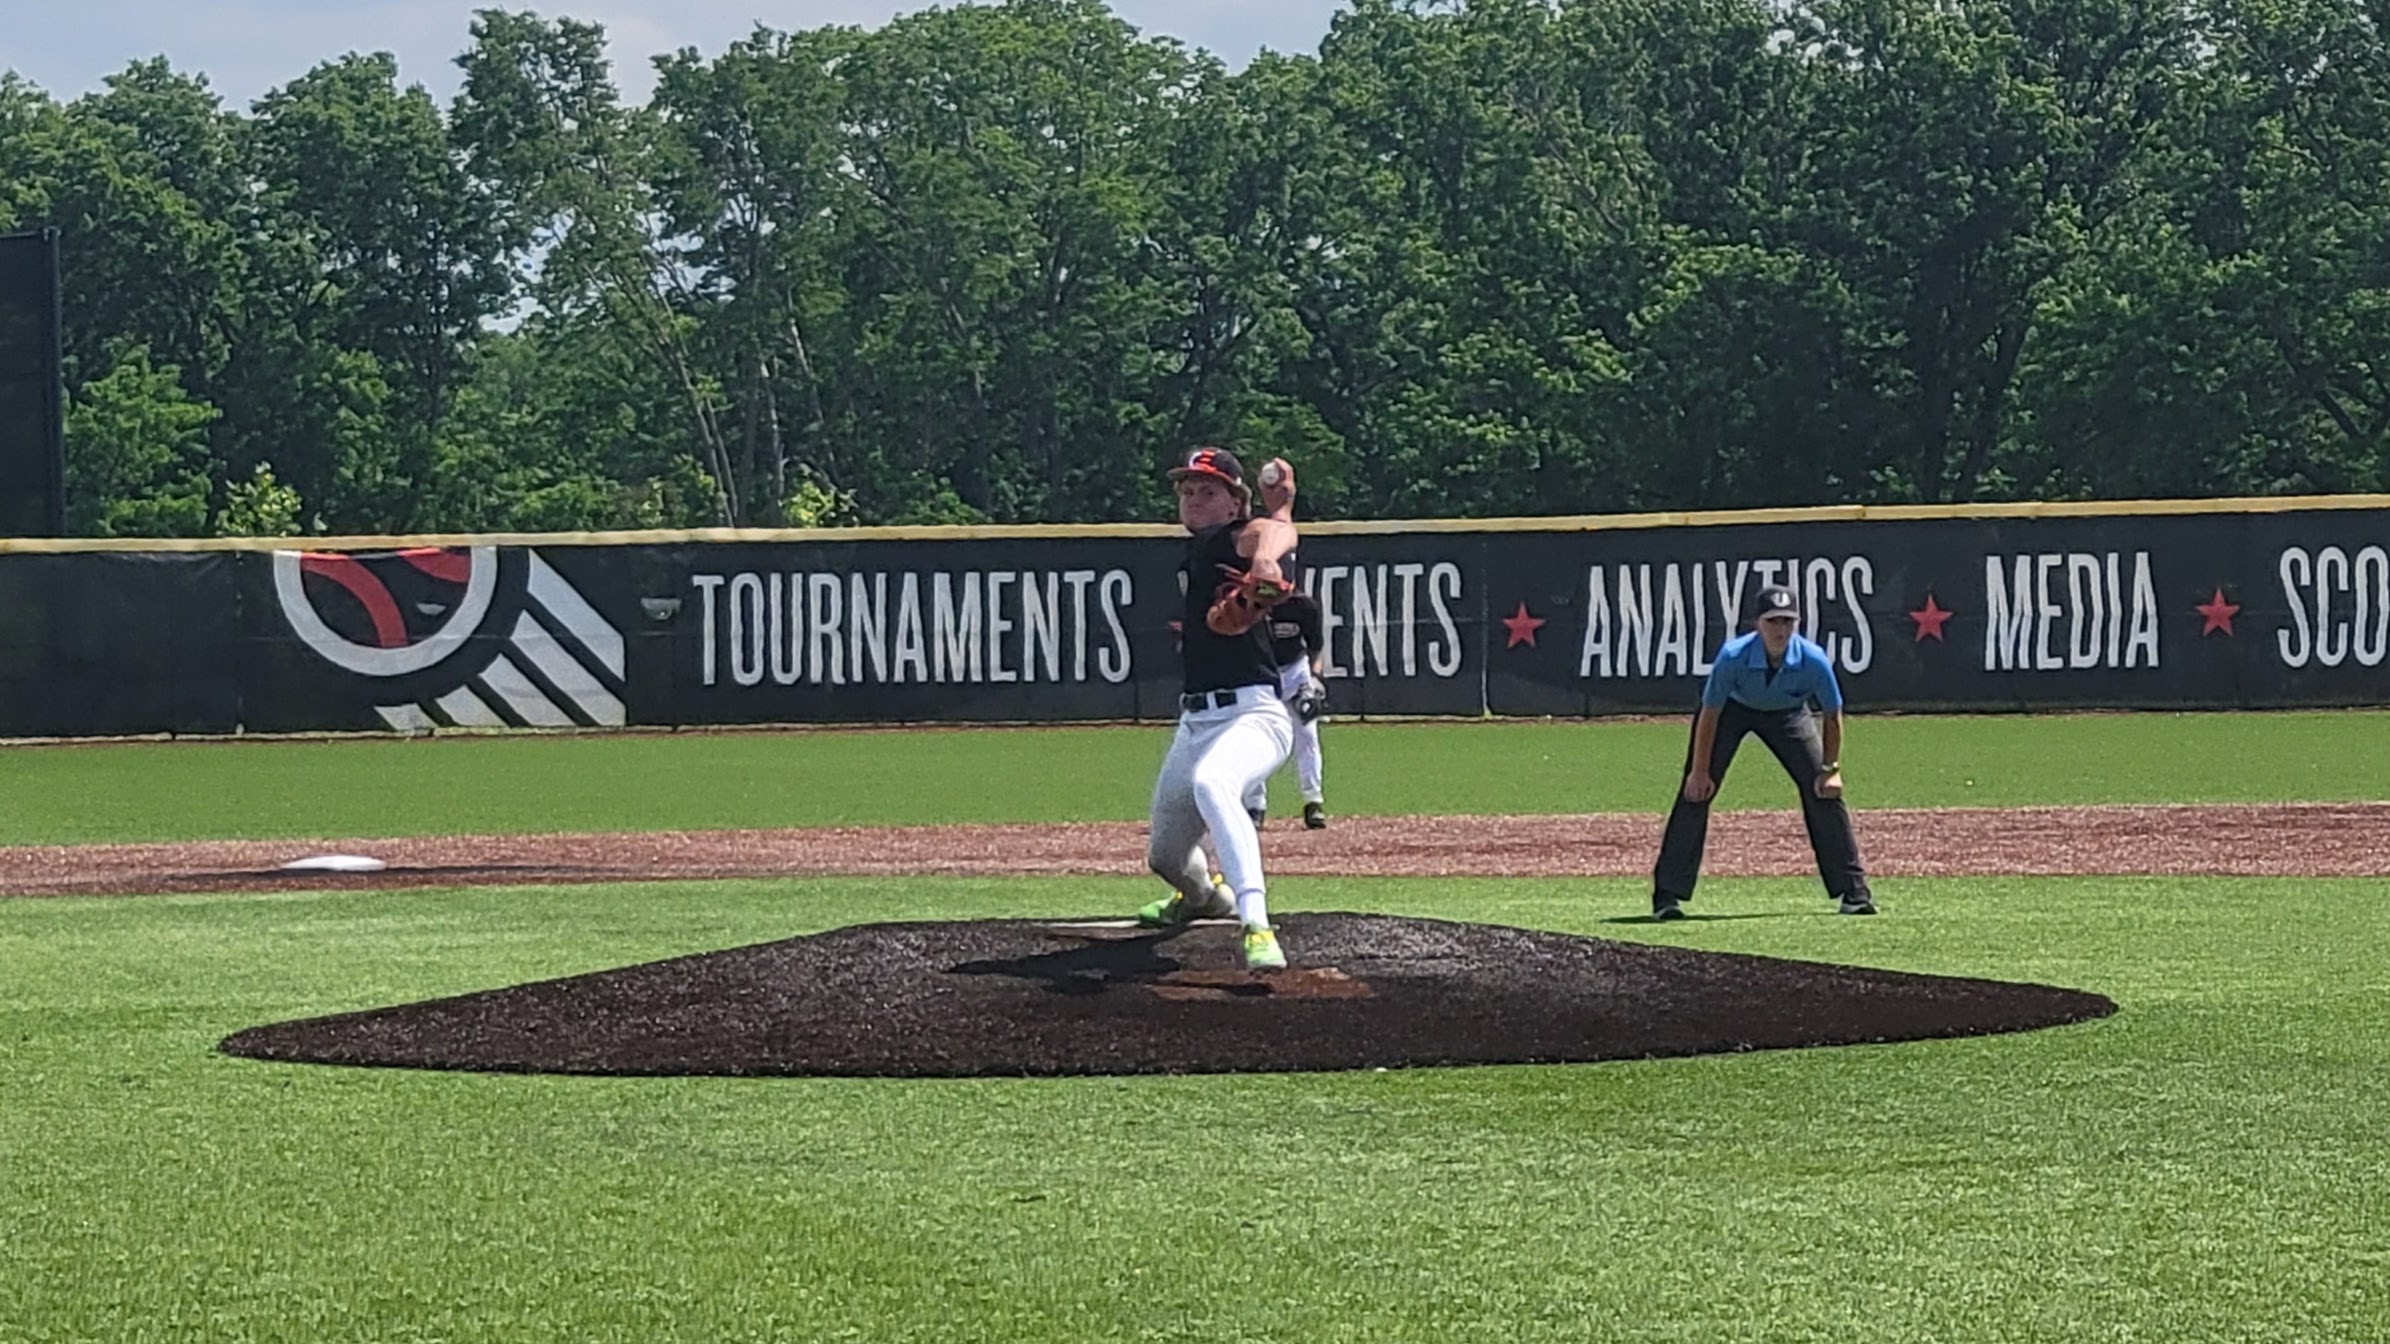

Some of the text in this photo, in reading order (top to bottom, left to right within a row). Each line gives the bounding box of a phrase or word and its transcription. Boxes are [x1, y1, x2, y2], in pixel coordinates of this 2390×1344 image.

[692, 569, 1133, 686] TOURNAMENTS
[1304, 562, 1462, 678] ENTS
[1985, 552, 2160, 671] MEDIA
[2277, 546, 2390, 668] SCO
